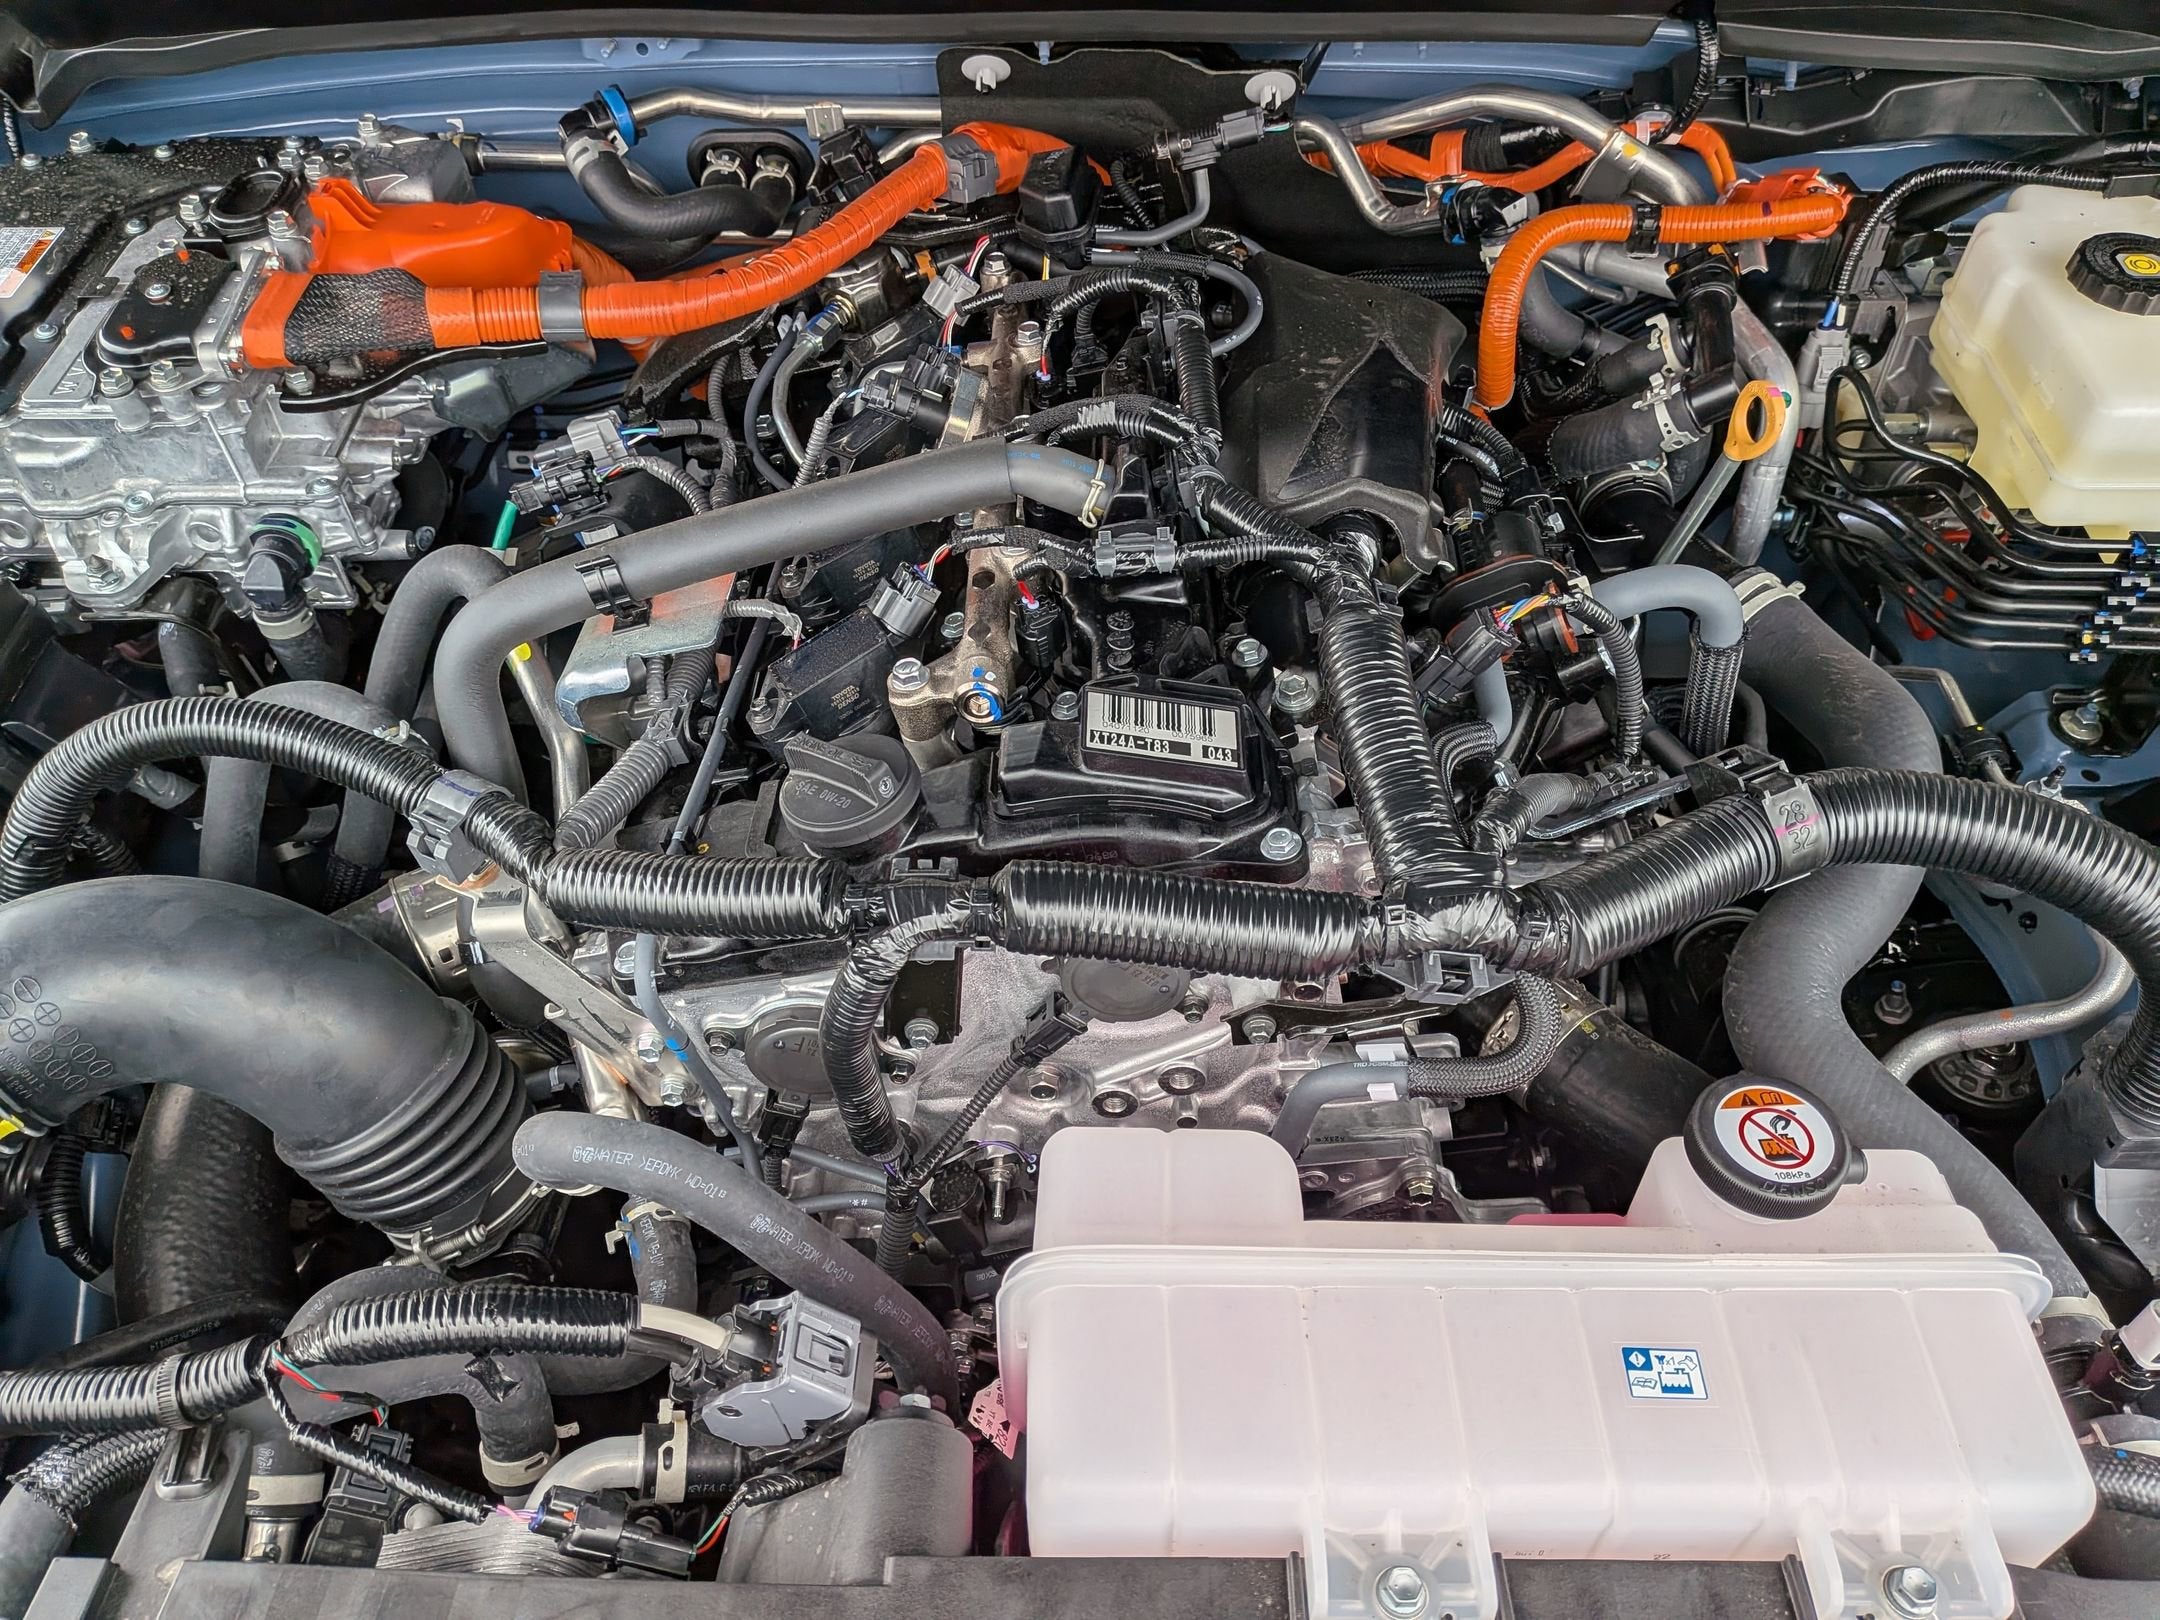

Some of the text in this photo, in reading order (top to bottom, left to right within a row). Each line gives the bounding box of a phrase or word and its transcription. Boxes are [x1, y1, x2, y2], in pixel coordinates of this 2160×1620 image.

[831, 685, 856, 701] TOYOTA
[837, 693, 860, 710] DENSO
[1092, 731, 1233, 762] XT24A-T83 043
[795, 781, 852, 810] SAE 0W-20
[1778, 799, 1806, 831] 28
[1788, 824, 1818, 855] 32
[1759, 1177, 1828, 1198] DENSO
[1774, 1171, 1812, 1182] 108kPa
